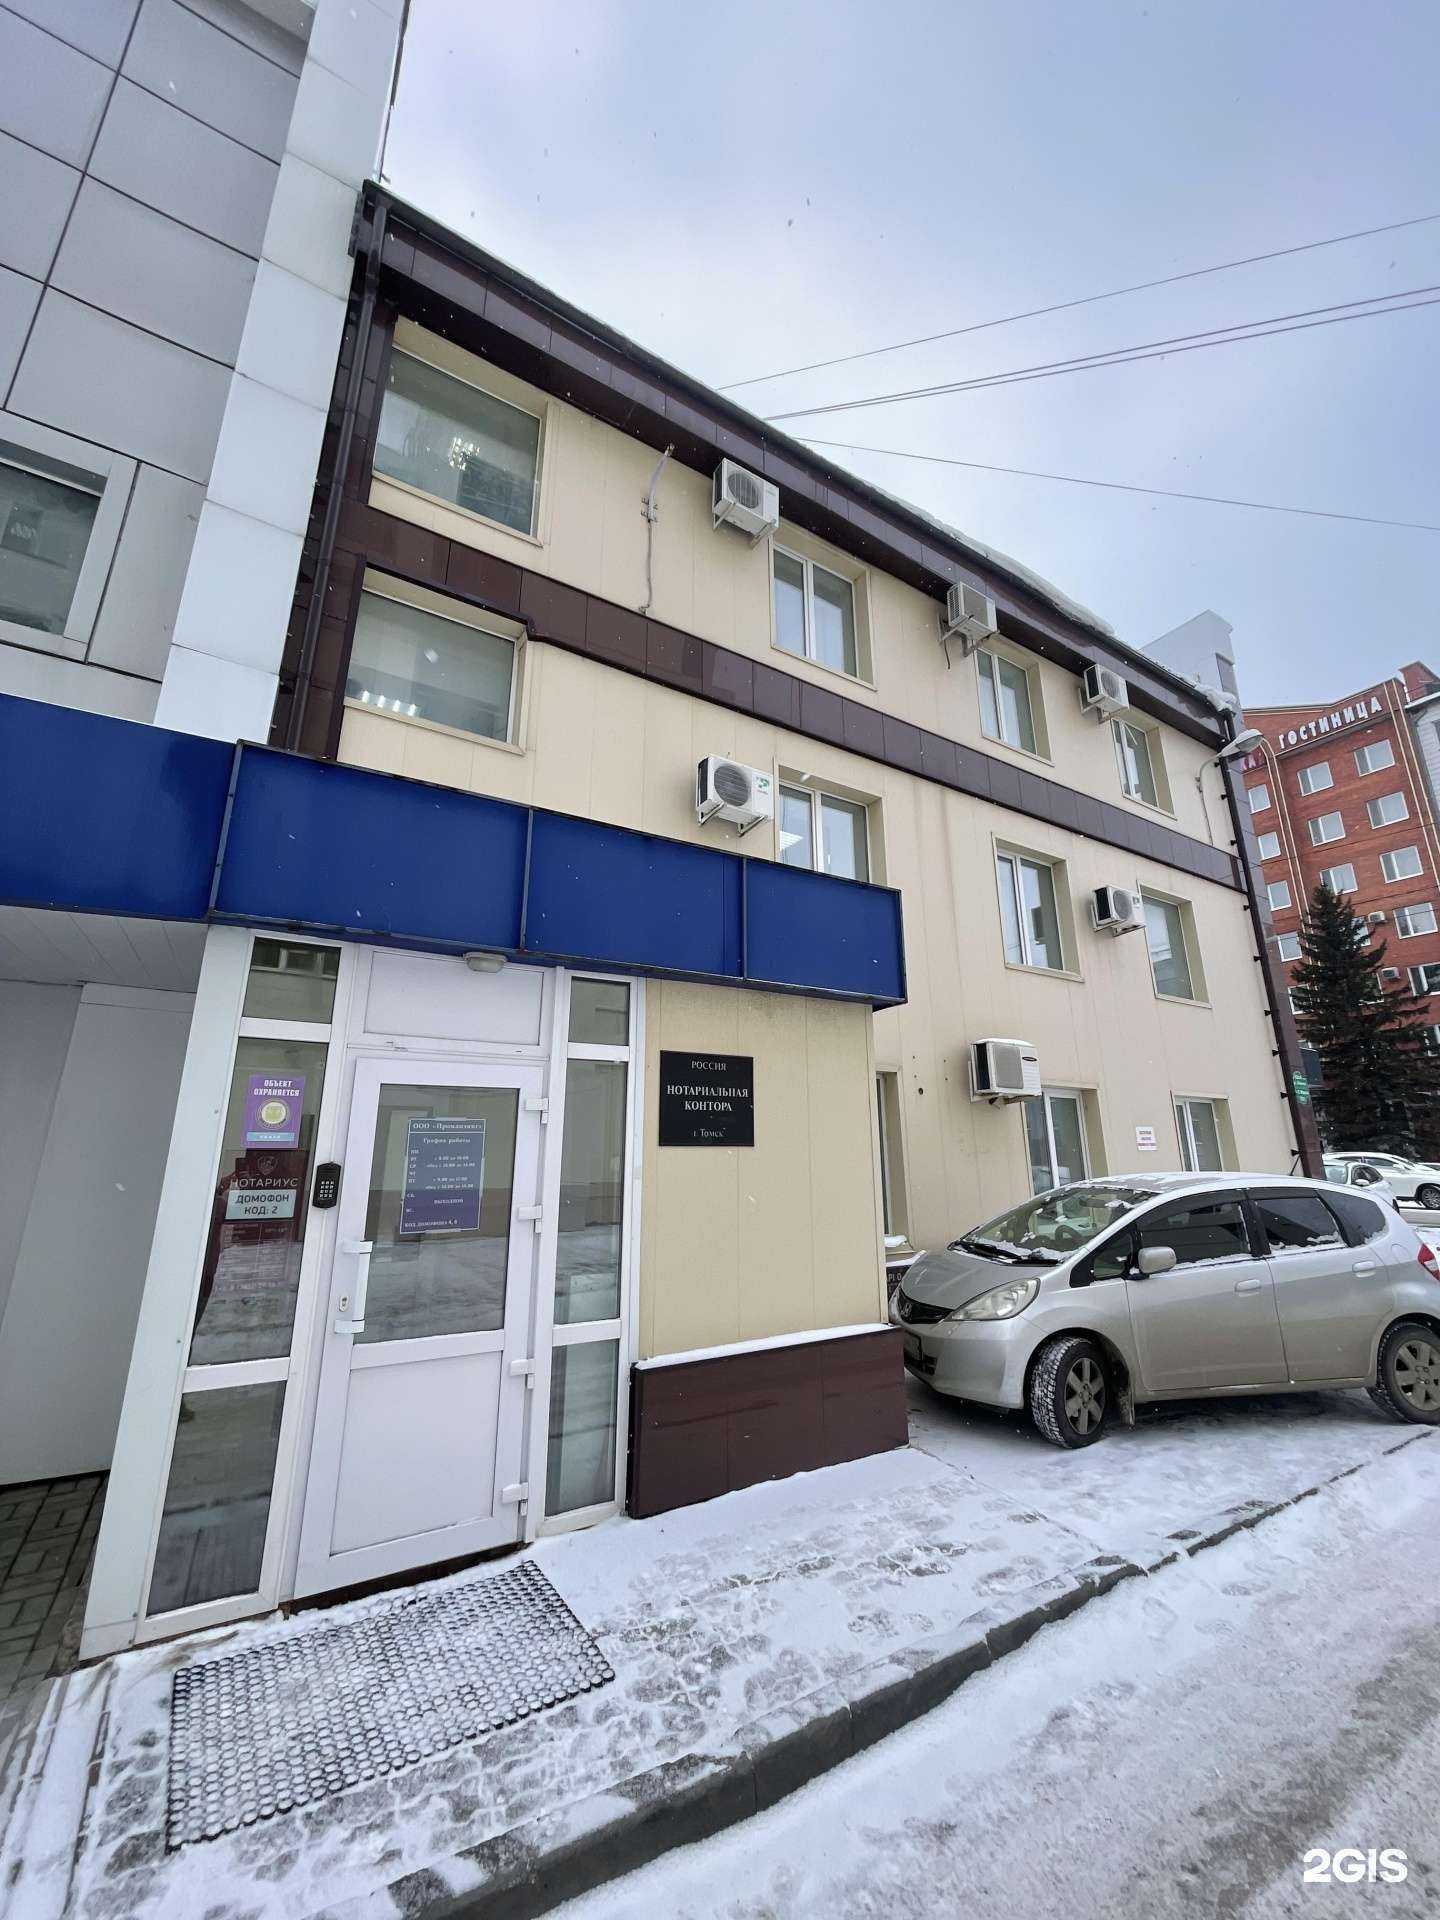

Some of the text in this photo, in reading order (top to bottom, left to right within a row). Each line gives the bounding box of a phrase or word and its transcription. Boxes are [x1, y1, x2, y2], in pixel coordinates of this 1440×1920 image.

[1278, 696, 1382, 749] ГОСТИНИЦА
[691, 1060, 727, 1071] РОССИЯ
[264, 1079, 293, 1087] ОБЪЕКТ
[254, 1088, 300, 1097] ОХРАНЯЕТСЯ
[667, 1084, 749, 1098] НОТАРИАЛЬНАЯ
[684, 1100, 732, 1111] КОНТОРА
[230, 1177, 298, 1187] НОТАРИУС
[235, 1194, 289, 1204] ДОМОФОН
[244, 1206, 278, 1216] КОД: 2
